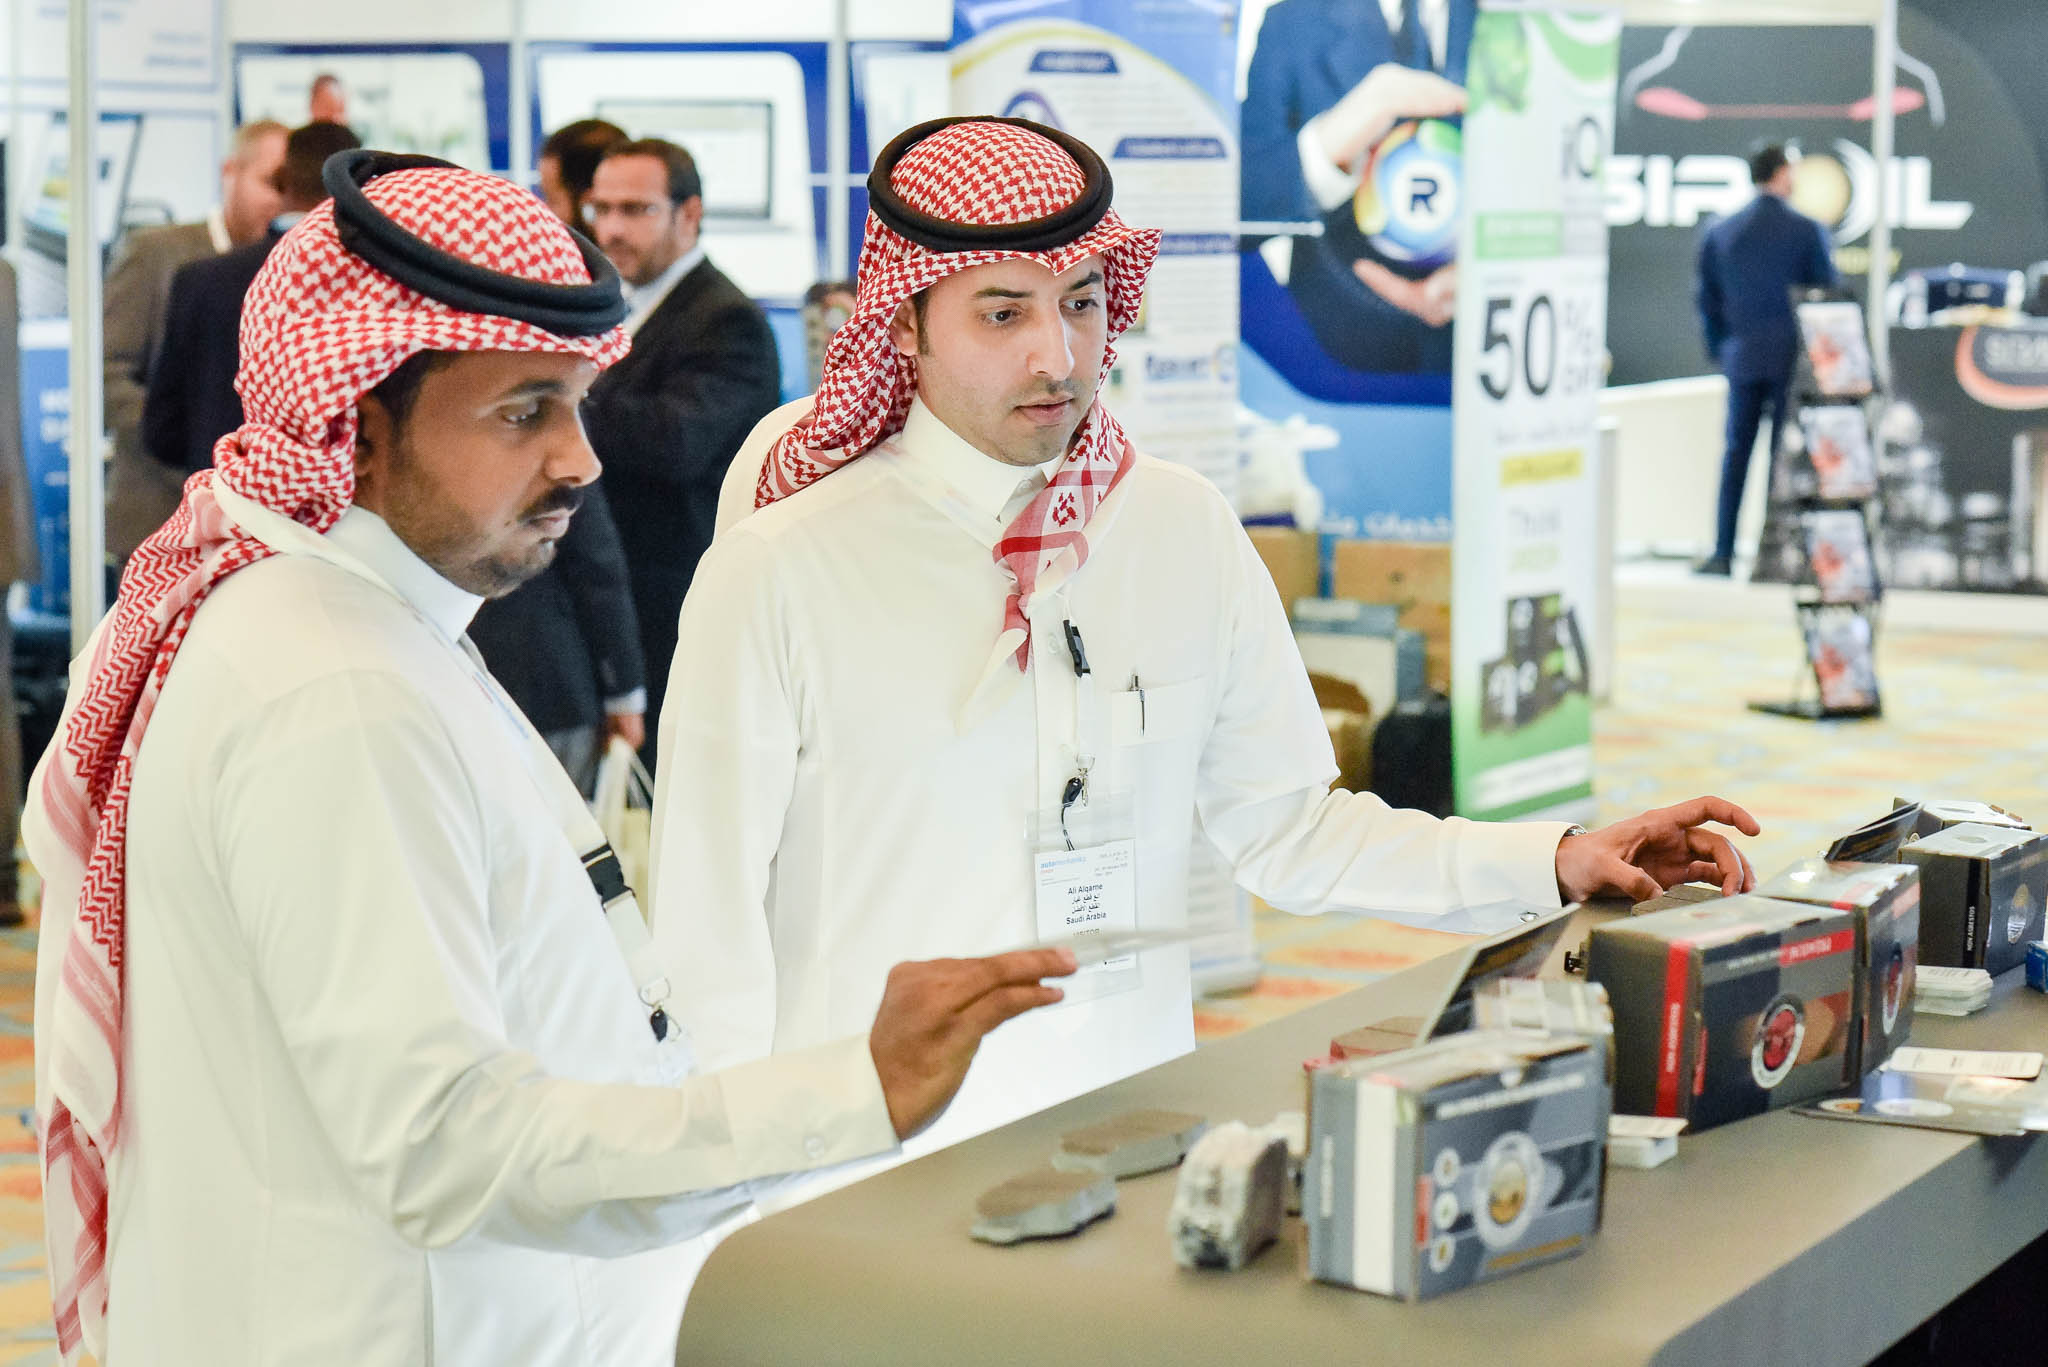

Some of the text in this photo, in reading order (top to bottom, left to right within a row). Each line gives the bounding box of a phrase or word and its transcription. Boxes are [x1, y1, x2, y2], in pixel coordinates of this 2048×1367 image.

[1410, 177, 1439, 213] R
[1068, 887, 1077, 895] Ali
[1066, 912, 1106, 924] Saudi Arabia
